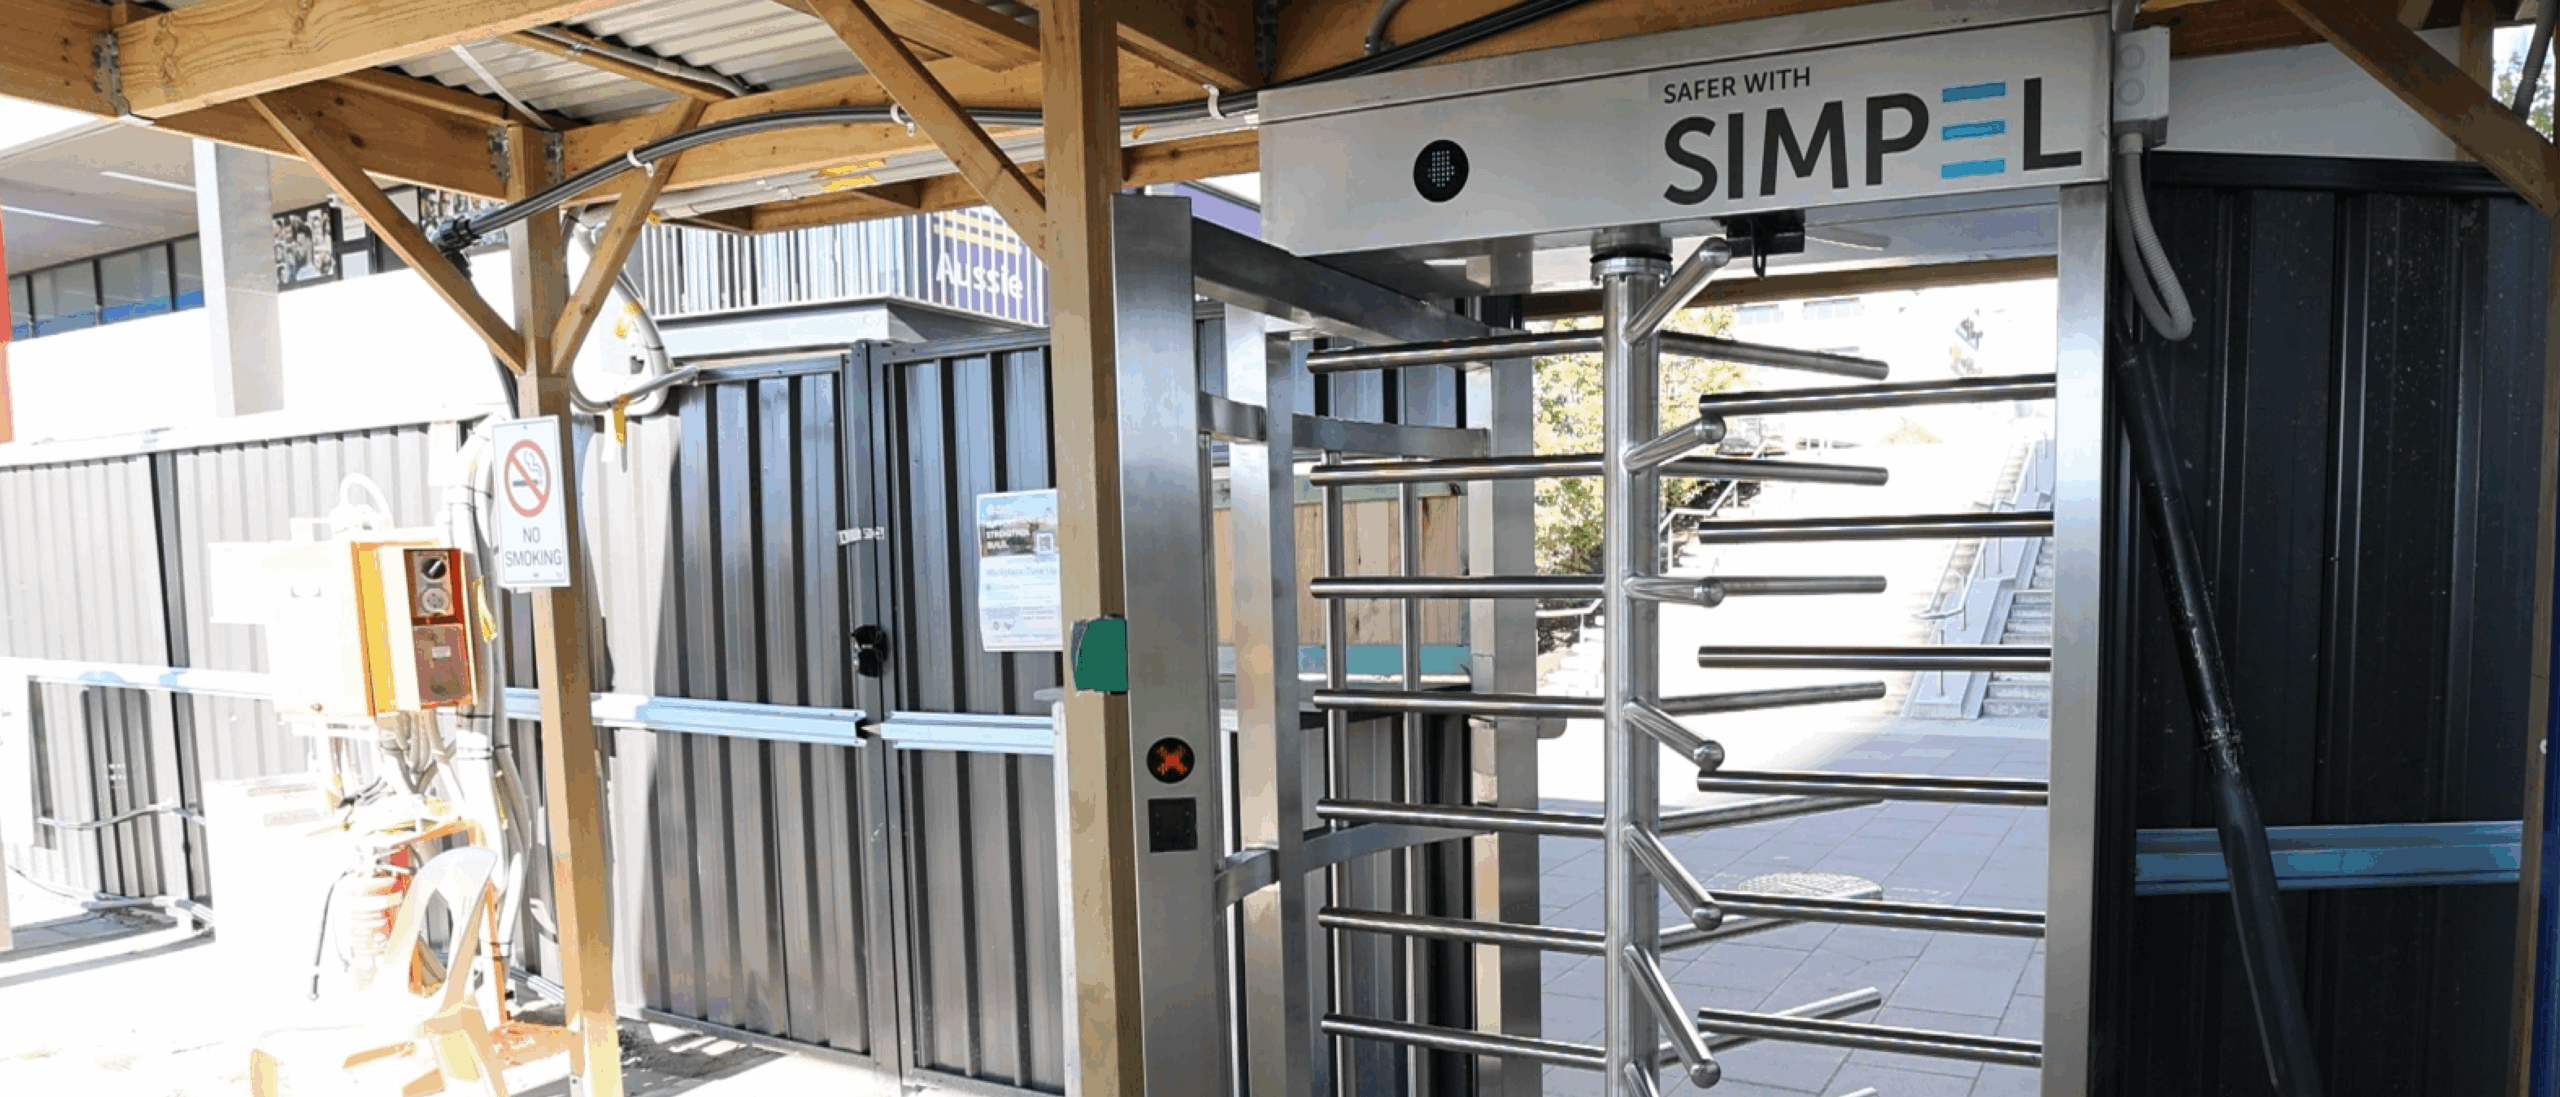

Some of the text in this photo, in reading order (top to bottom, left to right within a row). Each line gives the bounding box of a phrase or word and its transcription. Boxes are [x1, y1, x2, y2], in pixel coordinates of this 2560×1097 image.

[1663, 66, 1810, 104] SAFER WITH
[1663, 77, 2082, 206] SIMPEL
[935, 252, 1023, 300] Aussie
[522, 526, 541, 544] NO
[504, 547, 563, 568] SMOKING
